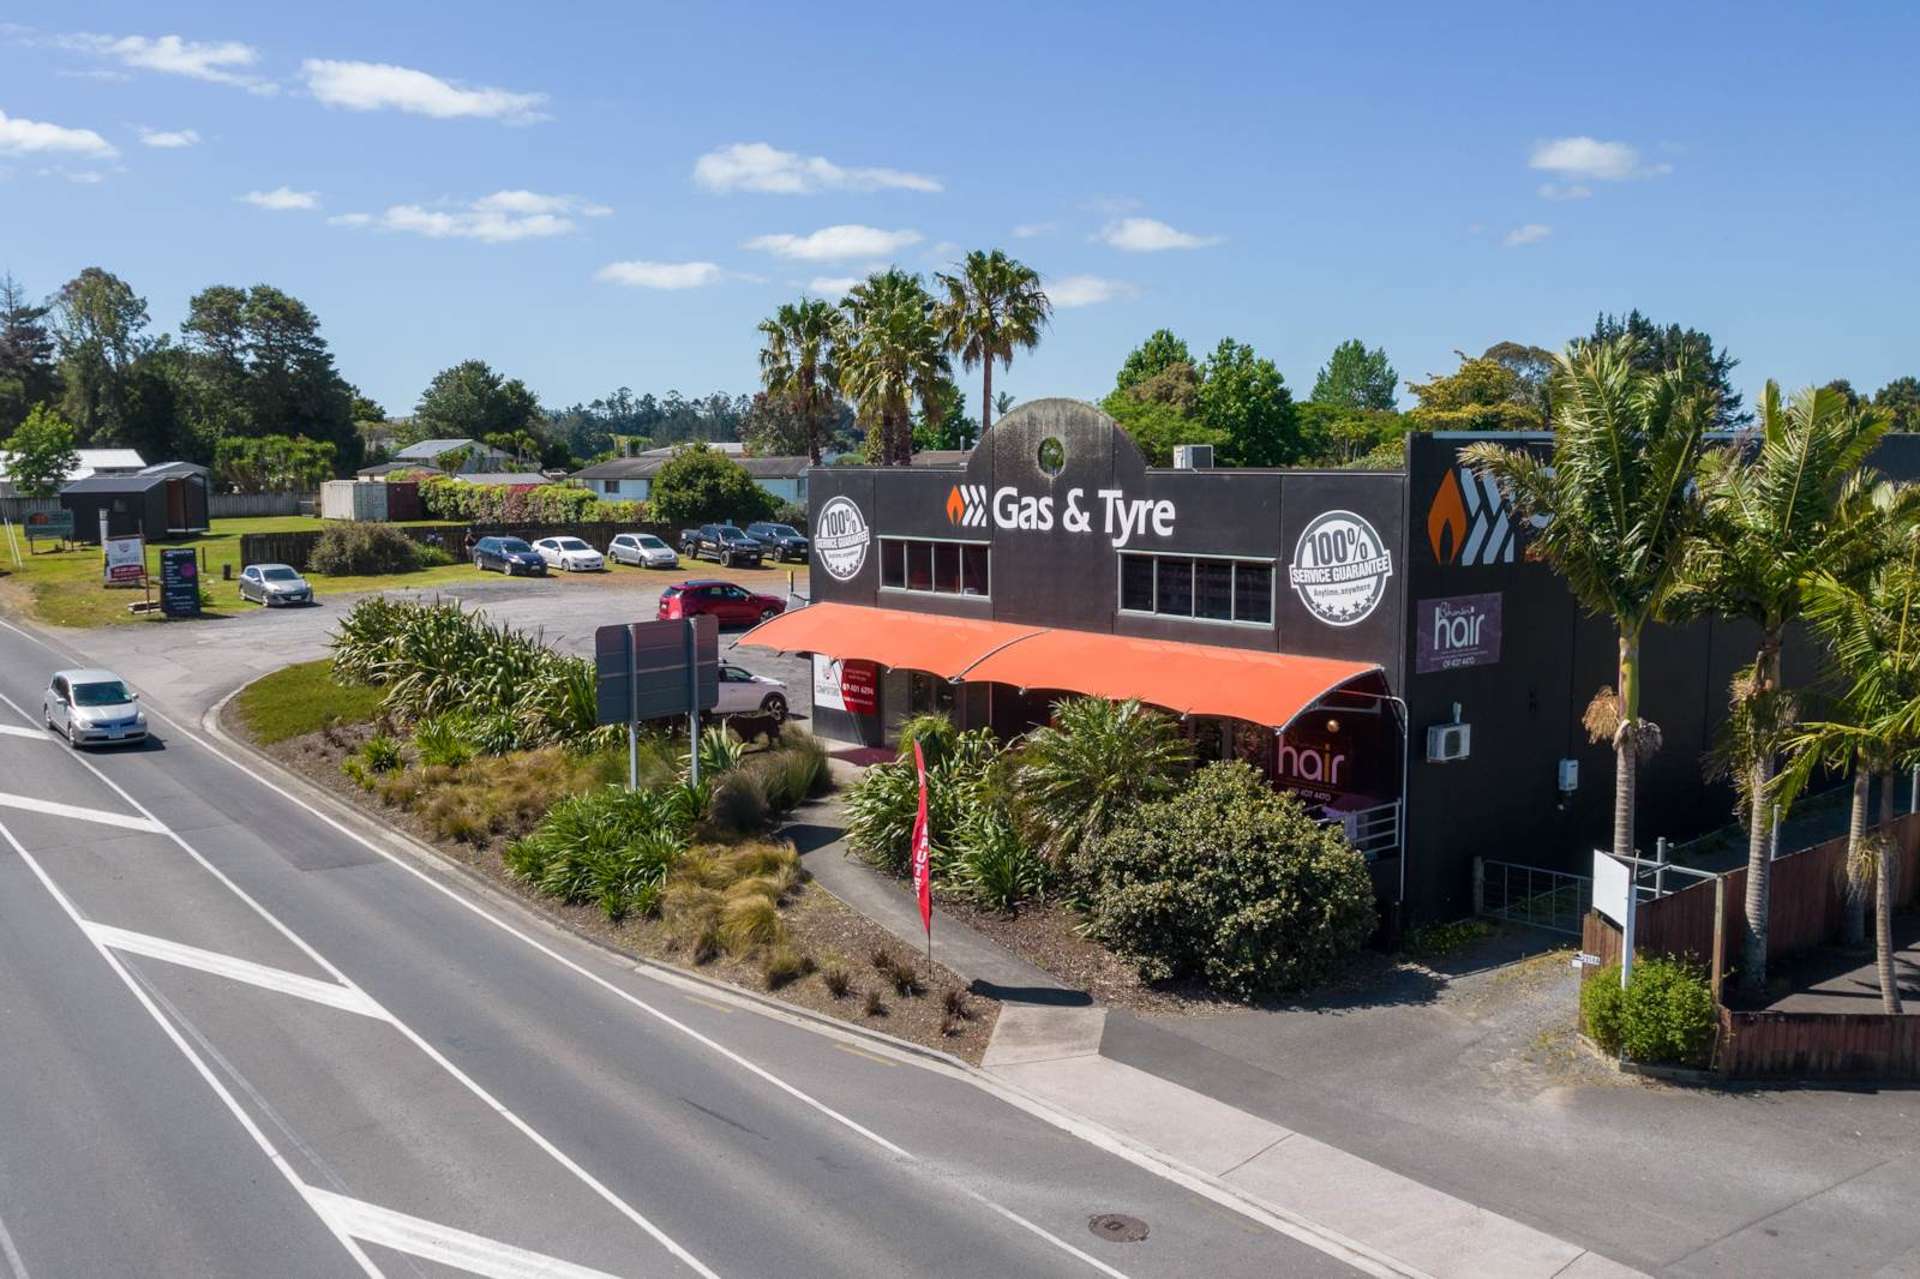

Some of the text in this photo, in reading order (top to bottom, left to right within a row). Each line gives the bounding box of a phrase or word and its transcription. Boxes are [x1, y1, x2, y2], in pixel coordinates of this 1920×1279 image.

[823, 509, 857, 537] 100%
[993, 486, 1176, 548] Gas & Tyre
[1306, 525, 1368, 567] 100%
[1292, 556, 1389, 584] SERVICE GUARANTEE
[1434, 606, 1486, 651] hair
[1278, 734, 1345, 784] hair
